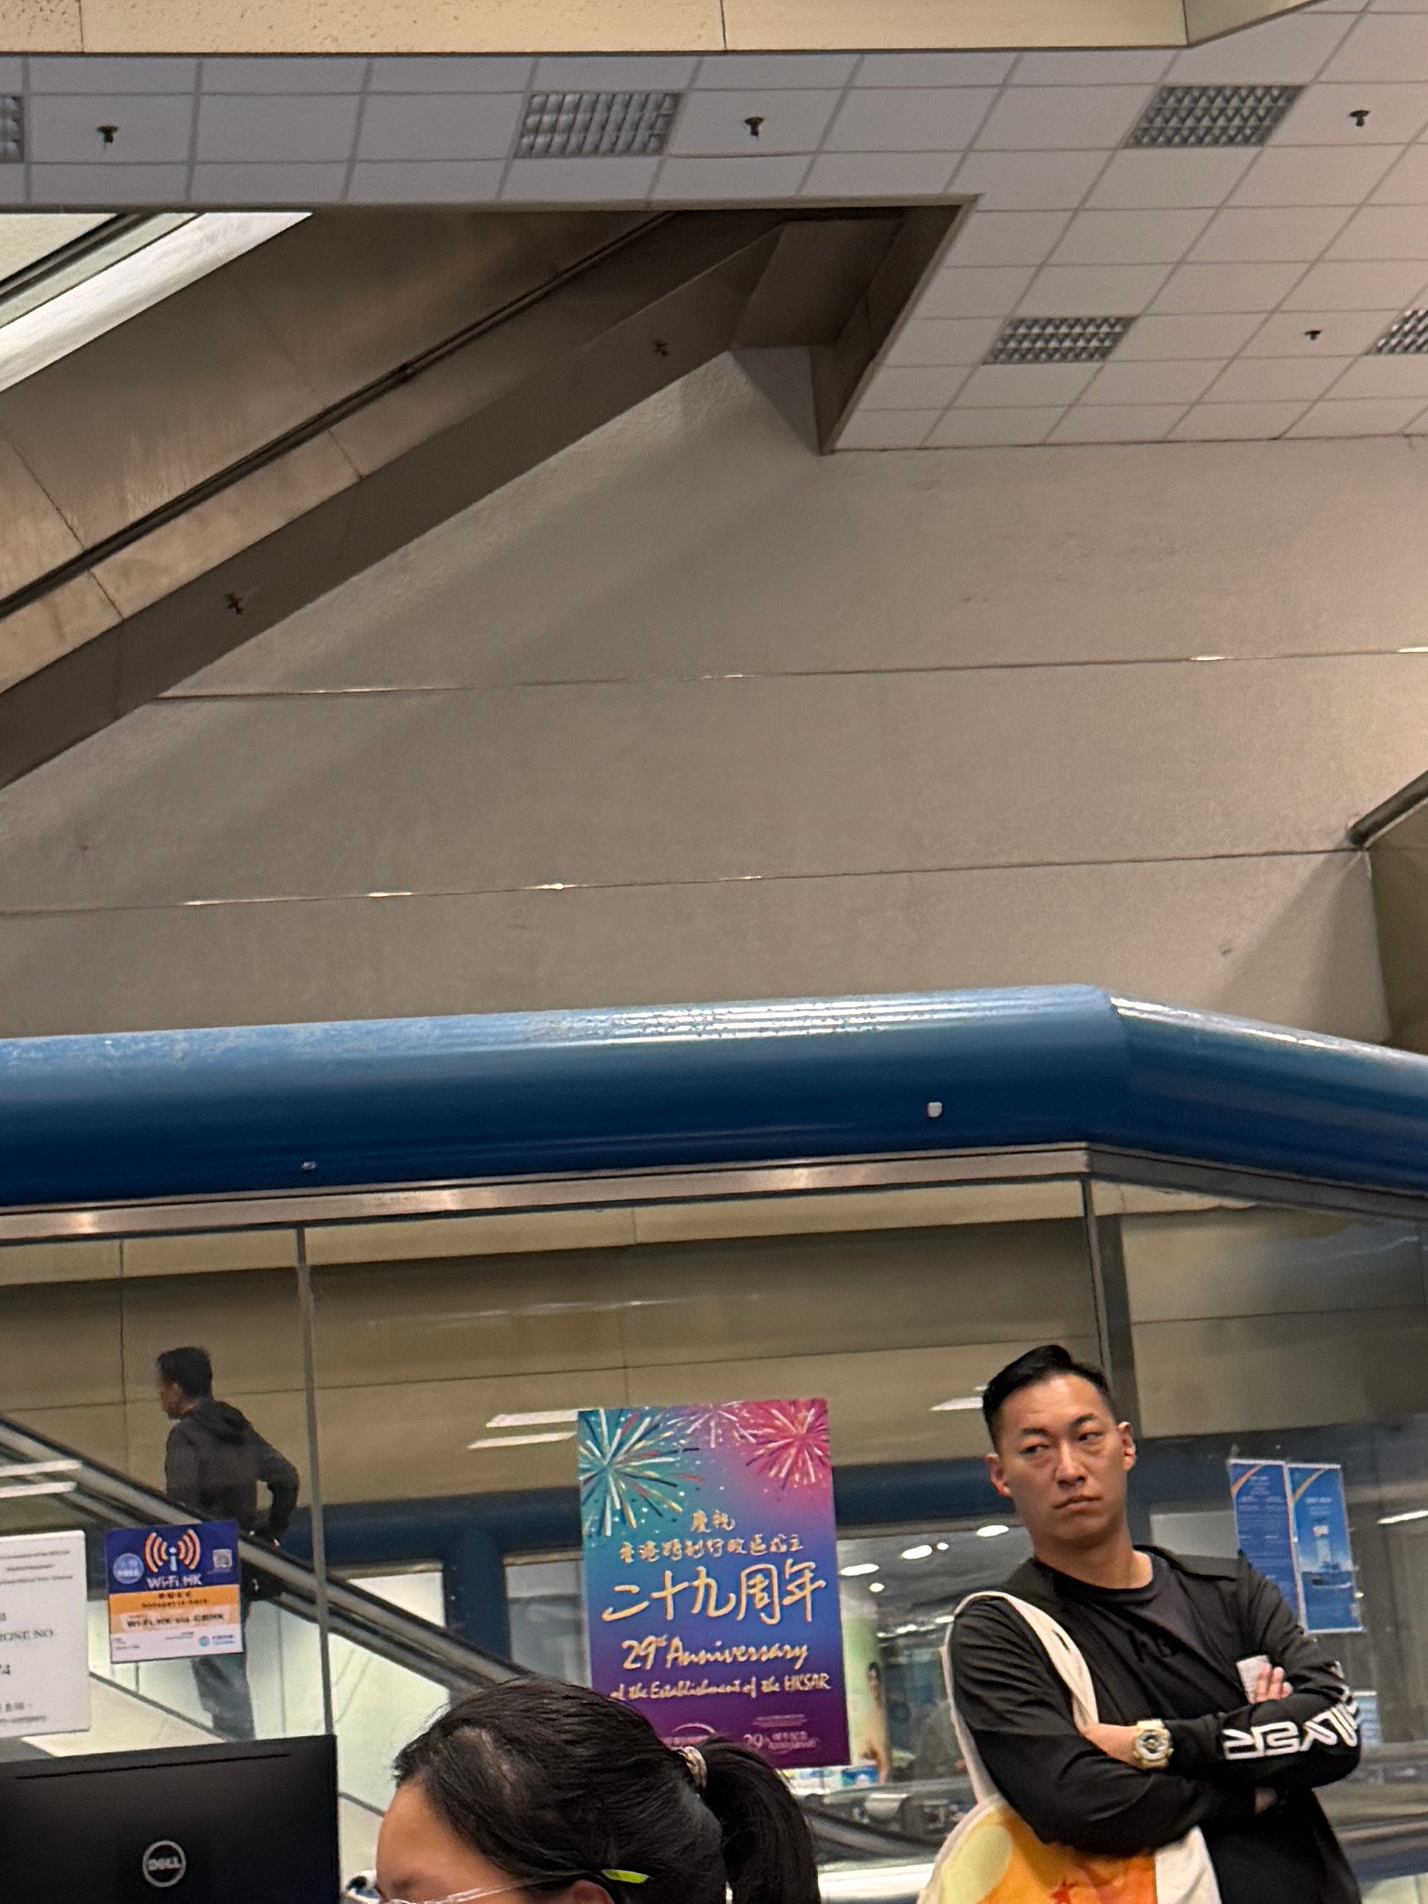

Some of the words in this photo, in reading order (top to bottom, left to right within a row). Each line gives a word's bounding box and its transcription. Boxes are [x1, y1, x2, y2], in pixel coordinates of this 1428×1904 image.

[601, 1558, 826, 1625] 二十九周年
[666, 1636, 809, 1670] Anniversary
[784, 1672, 831, 1692] HKSAR
[148, 1857, 181, 1871] DELL
